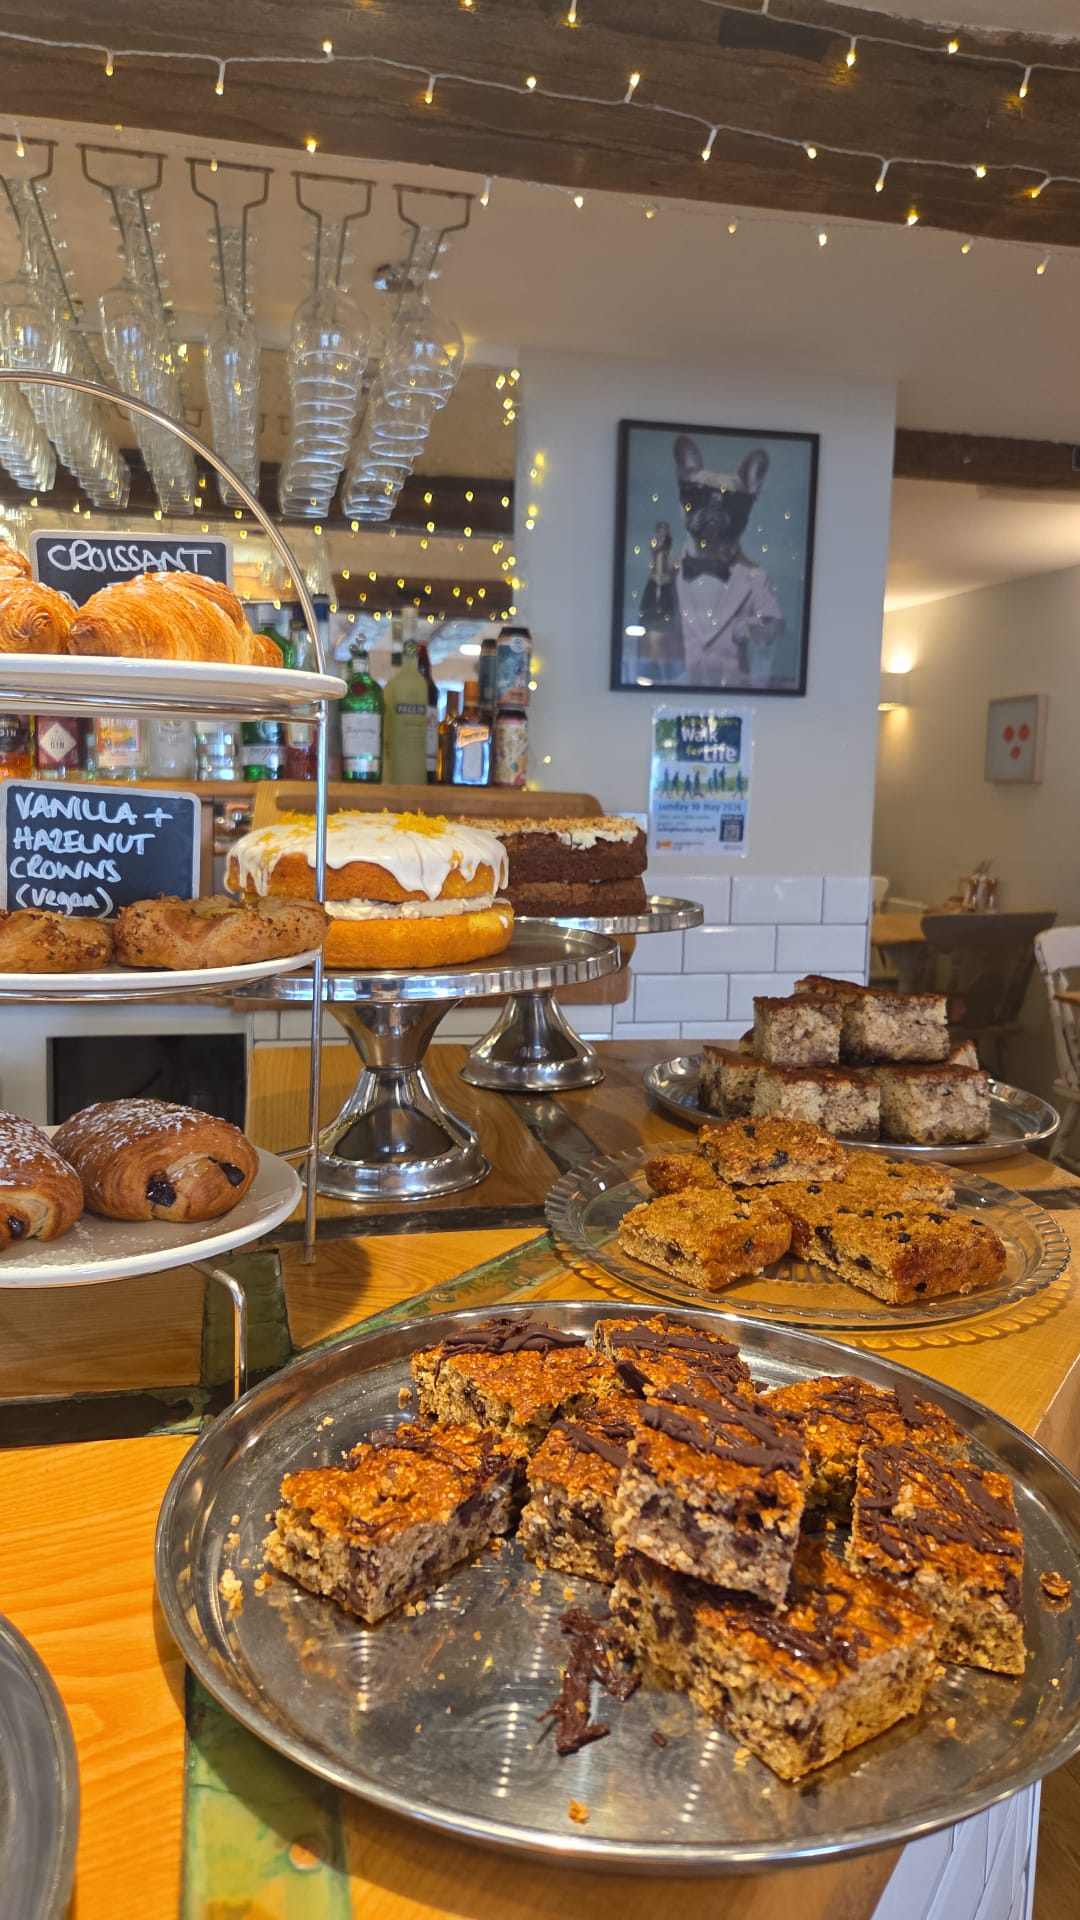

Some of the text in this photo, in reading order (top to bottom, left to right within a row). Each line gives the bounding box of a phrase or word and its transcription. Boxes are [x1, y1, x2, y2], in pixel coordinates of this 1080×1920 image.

[47, 540, 212, 573] CROISSANT
[681, 726, 718, 743] Walk
[703, 743, 737, 762] Life
[15, 792, 174, 828] VANILLA +
[13, 825, 156, 856] HAZELNUT
[9, 854, 122, 883] CROWNS
[15, 883, 115, 919] (vegan)
